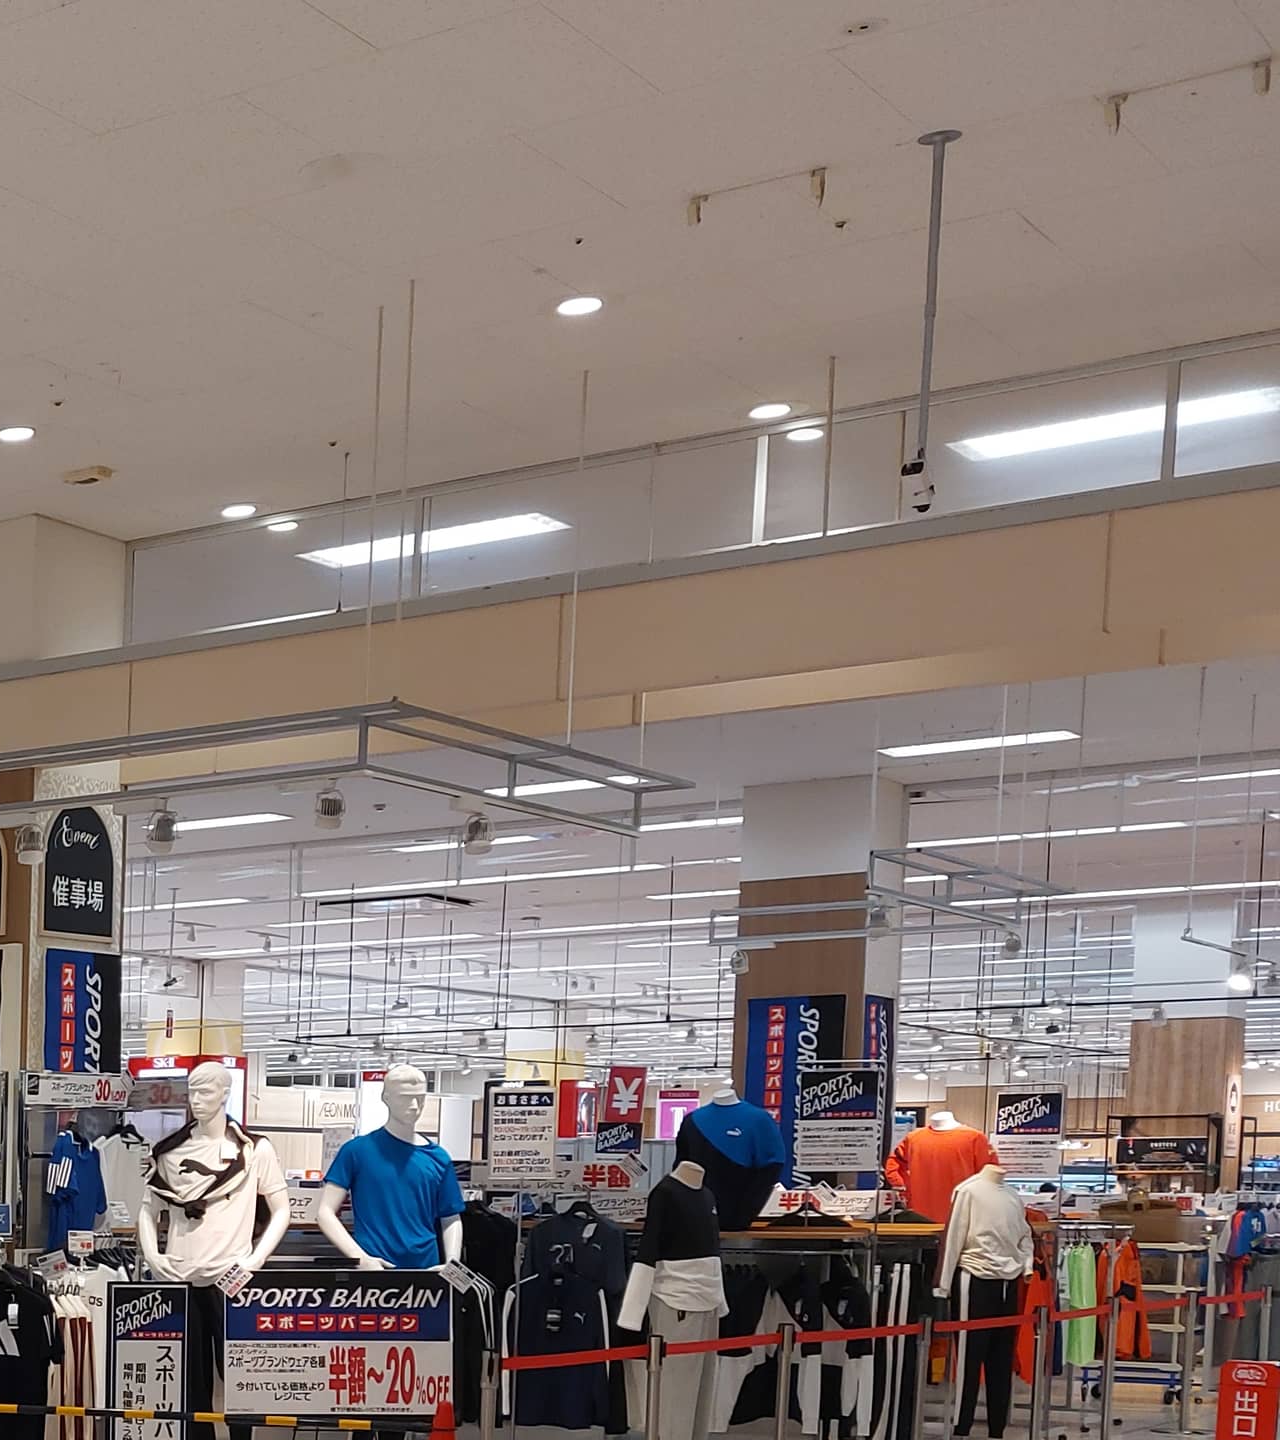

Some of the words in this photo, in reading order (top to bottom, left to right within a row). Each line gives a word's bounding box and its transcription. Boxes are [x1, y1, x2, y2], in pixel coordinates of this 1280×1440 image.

[55, 816, 101, 850] Event
[52, 875, 104, 912] 催事場
[766, 1008, 784, 1121] スポーツバーゲ
[802, 1072, 853, 1102] SPORTS
[803, 1081, 863, 1116] BARGAIN
[998, 1095, 1042, 1120] SPORTS
[998, 1102, 1050, 1132] BARGAIN
[597, 1130, 634, 1151] BARGAIN
[598, 1123, 628, 1141] SPORTS
[115, 1290, 162, 1321] SPORTS
[232, 1288, 327, 1309] SPORTS
[330, 1284, 443, 1309] BARGAIN
[116, 1300, 172, 1337] BARGAIN
[259, 1315, 417, 1331] スポーツバーゲン
[228, 1355, 326, 1368] スポーツブランドウェア各種
[274, 1392, 312, 1401] レジにて
[1233, 1390, 1258, 1437] 出口
